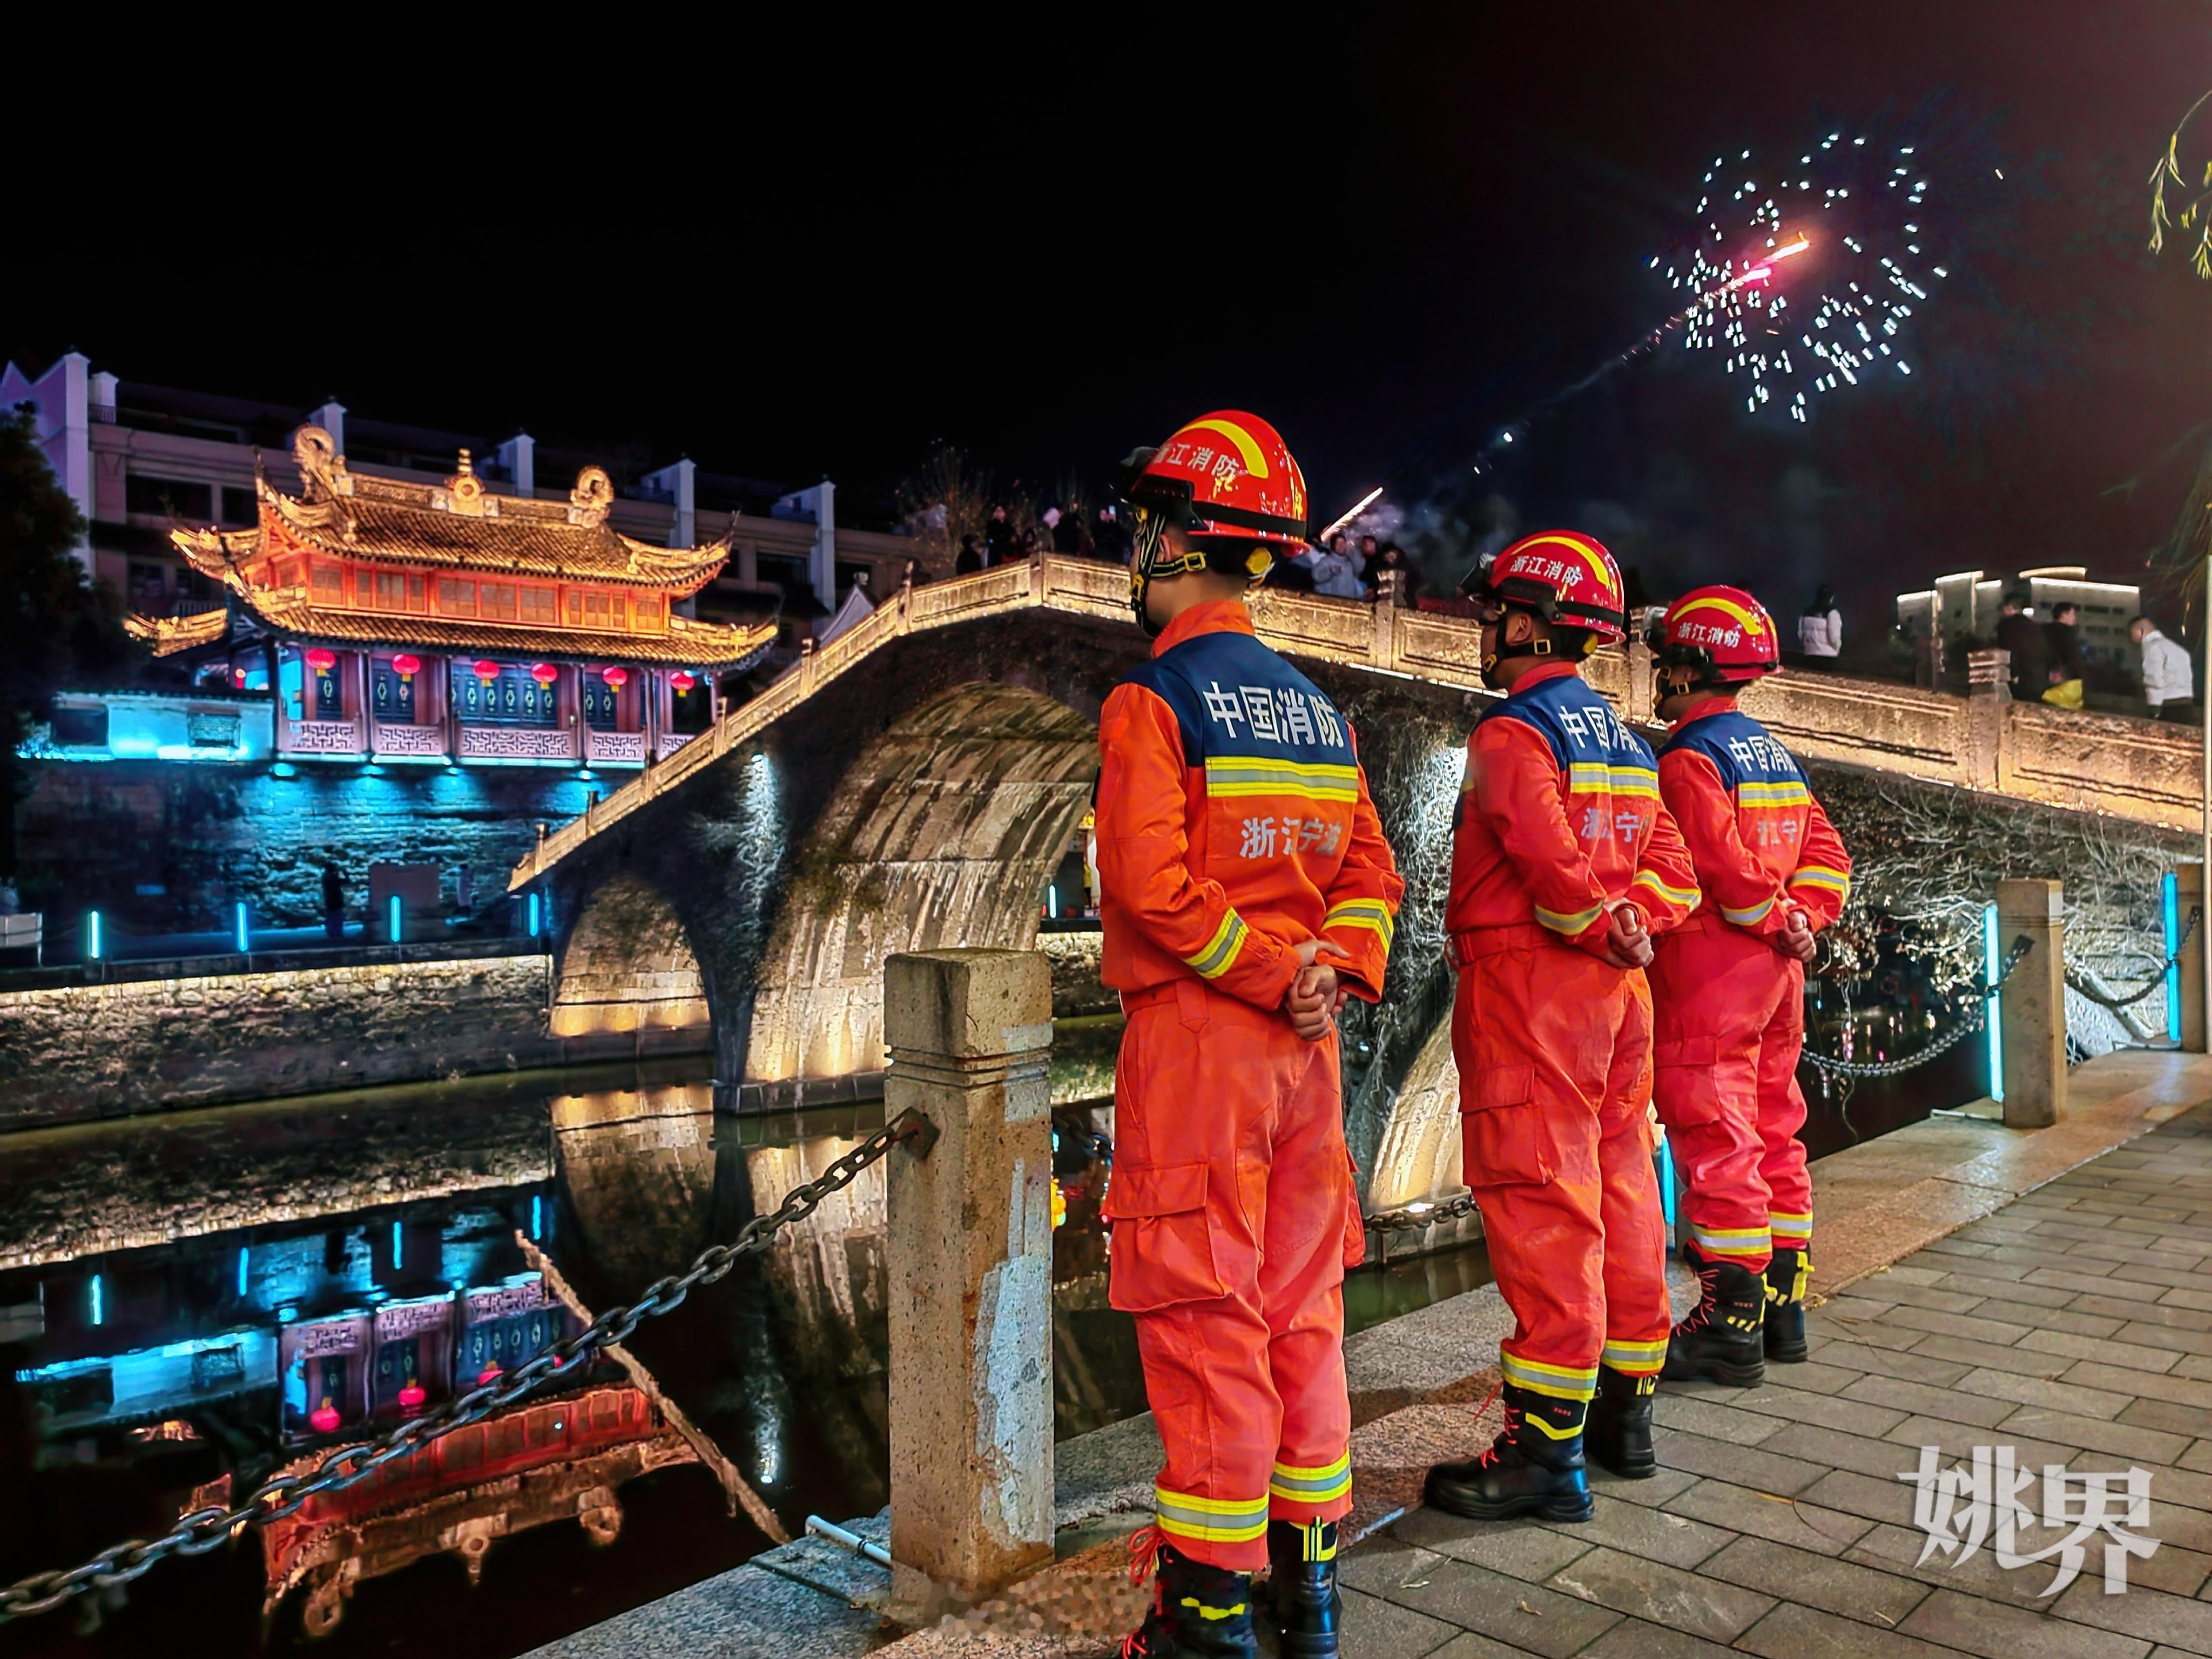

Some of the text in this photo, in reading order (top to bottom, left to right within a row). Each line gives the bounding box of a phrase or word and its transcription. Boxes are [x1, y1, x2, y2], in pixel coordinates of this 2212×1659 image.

[1509, 555, 1583, 586] 浙江消防
[1678, 622, 1741, 648] 浙江消防
[1203, 681, 1344, 747] 中国消防
[1559, 705, 1645, 755] 中国消
